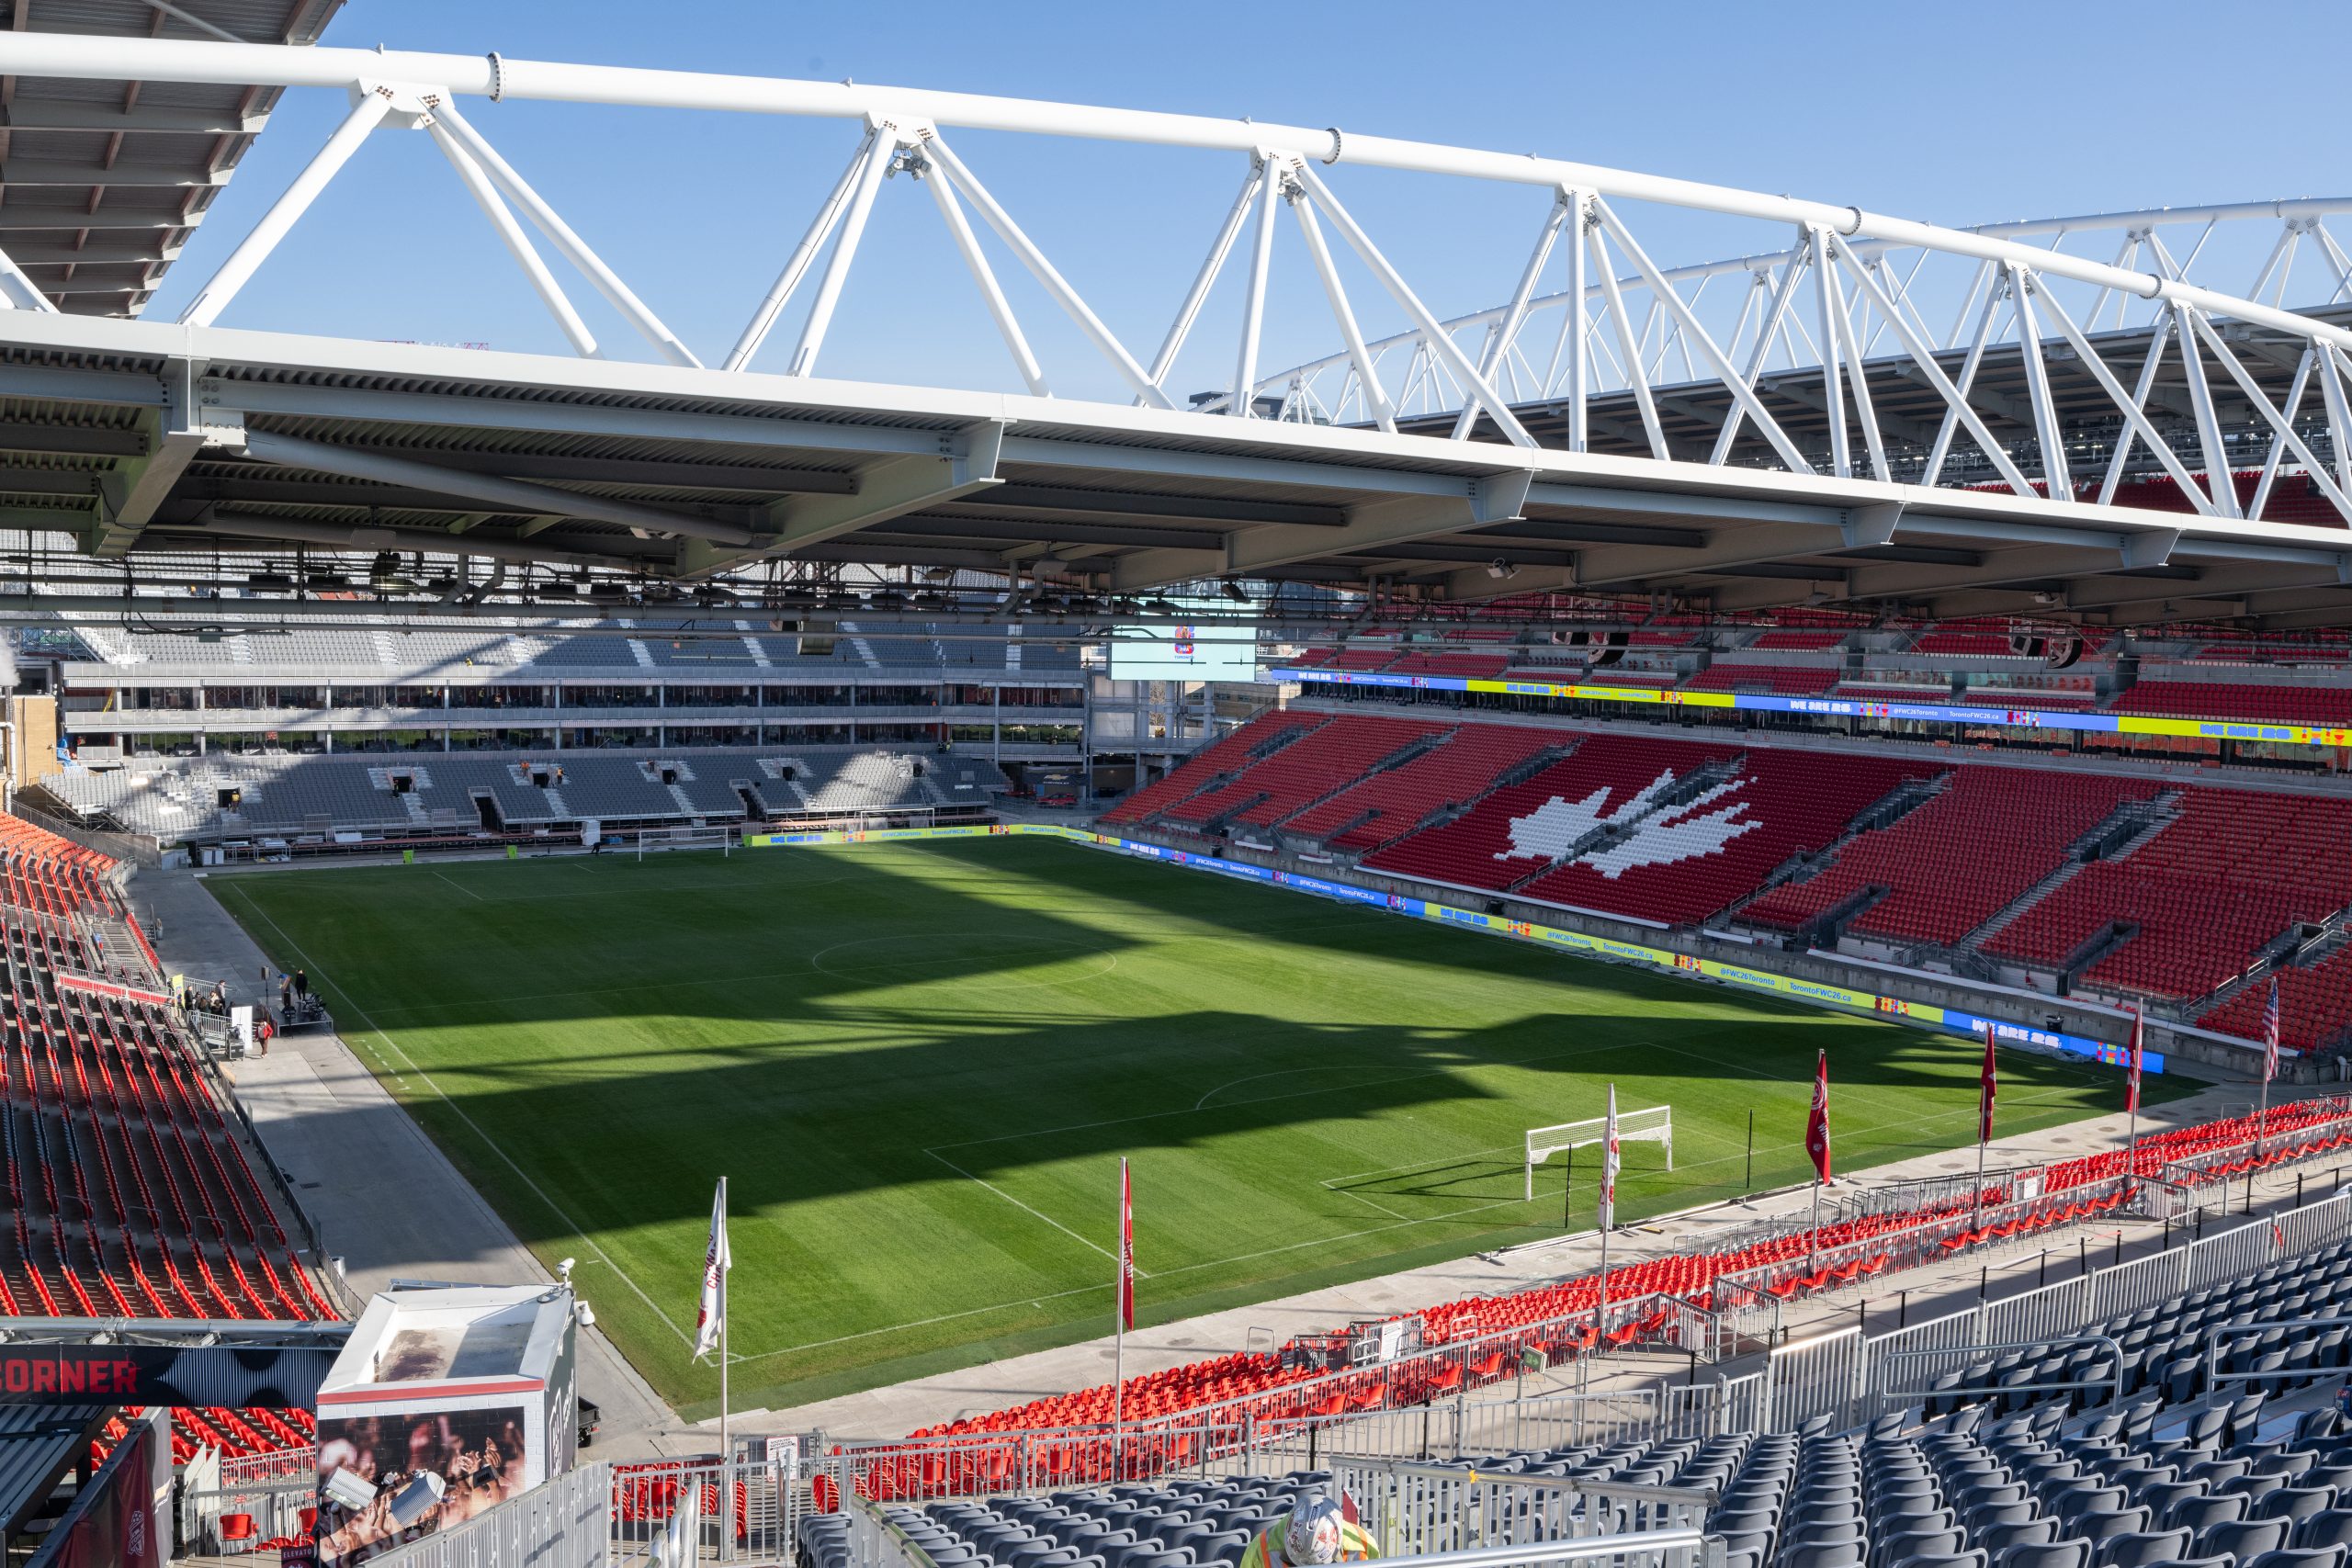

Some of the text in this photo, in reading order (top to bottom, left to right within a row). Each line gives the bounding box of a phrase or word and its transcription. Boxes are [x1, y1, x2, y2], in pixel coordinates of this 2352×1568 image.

[1790, 701, 1851, 712] WE ARE 26
[1894, 708, 1999, 719] @FWC26Toronto TorontoFWC26.ca
[2200, 724, 2290, 739] WE ARE 26
[1195, 859, 1261, 875] @FWC26Toronto TorontoFWC26.ca
[1300, 880, 1374, 900] @FWC26Toronto TorontoFWC26.ca
[1547, 932, 1653, 960] @FWC26Toronto TorontoFWC26.ca
[1720, 968, 1851, 1002] @FWC26Toronto TorontoFWC26.ca
[1997, 1025, 2029, 1041] ARE
[2031, 1032, 2059, 1047] 26
[0, 1359, 139, 1393] ORNER
